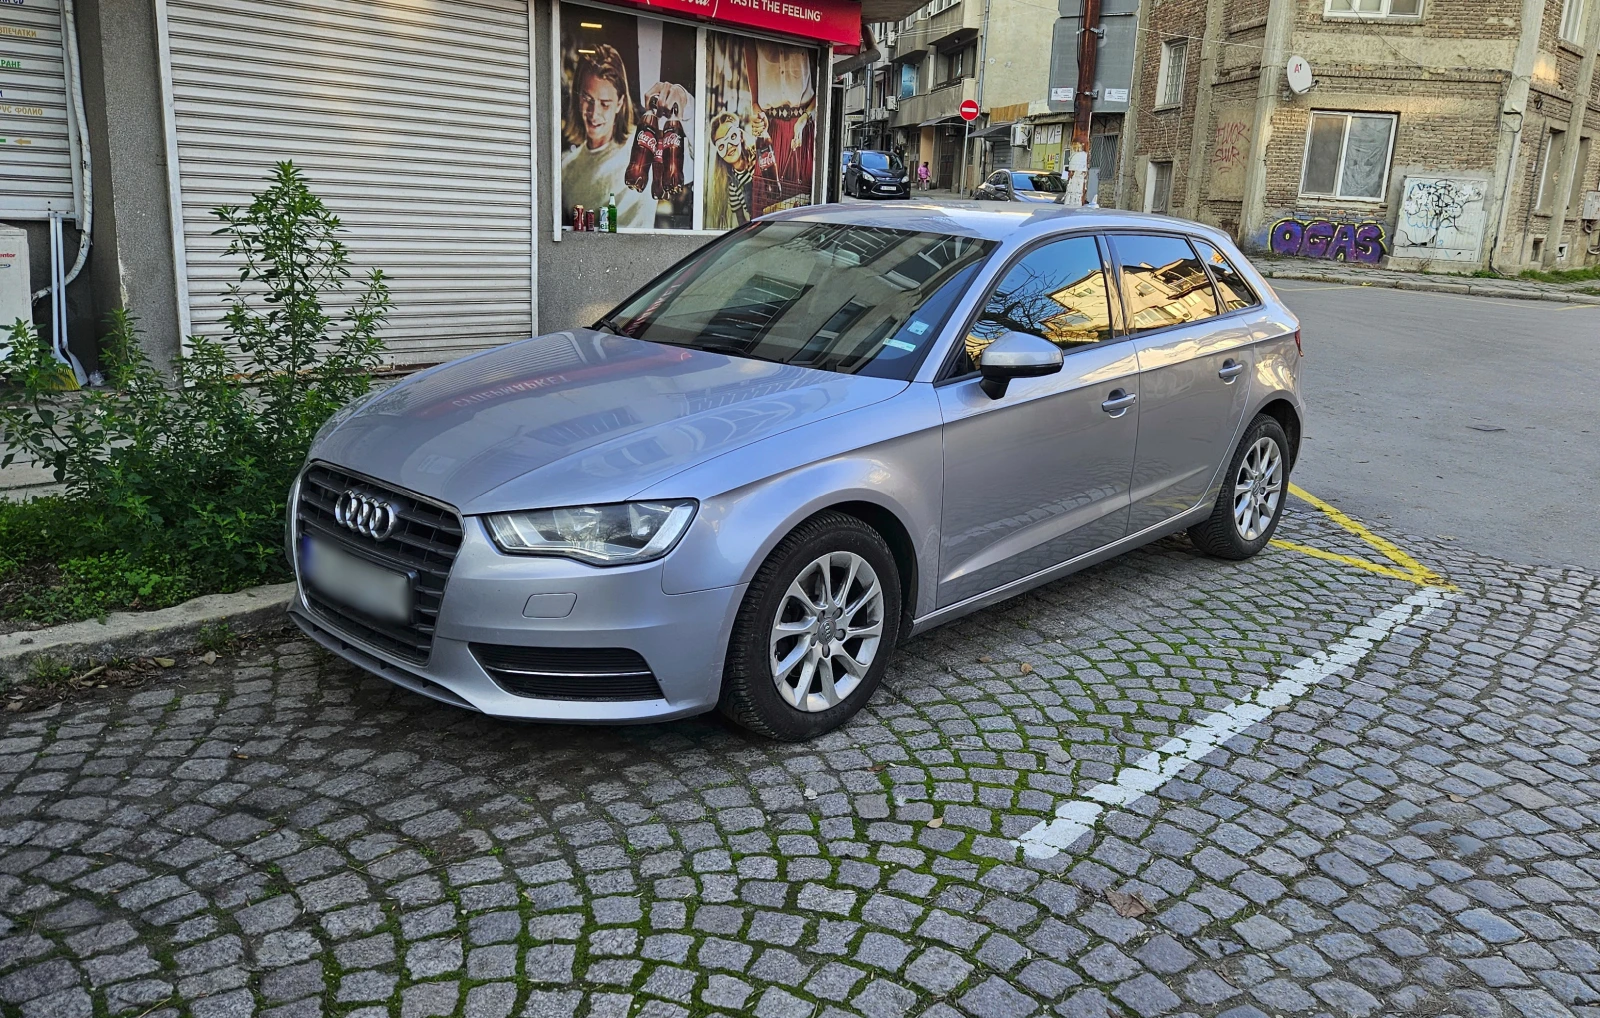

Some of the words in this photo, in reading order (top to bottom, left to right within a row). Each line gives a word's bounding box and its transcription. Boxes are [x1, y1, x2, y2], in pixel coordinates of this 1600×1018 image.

[762, 0, 780, 14] THE
[782, 3, 821, 22] FEELING
[1294, 63, 1302, 73] A1
[1268, 217, 1388, 264] OGAS
